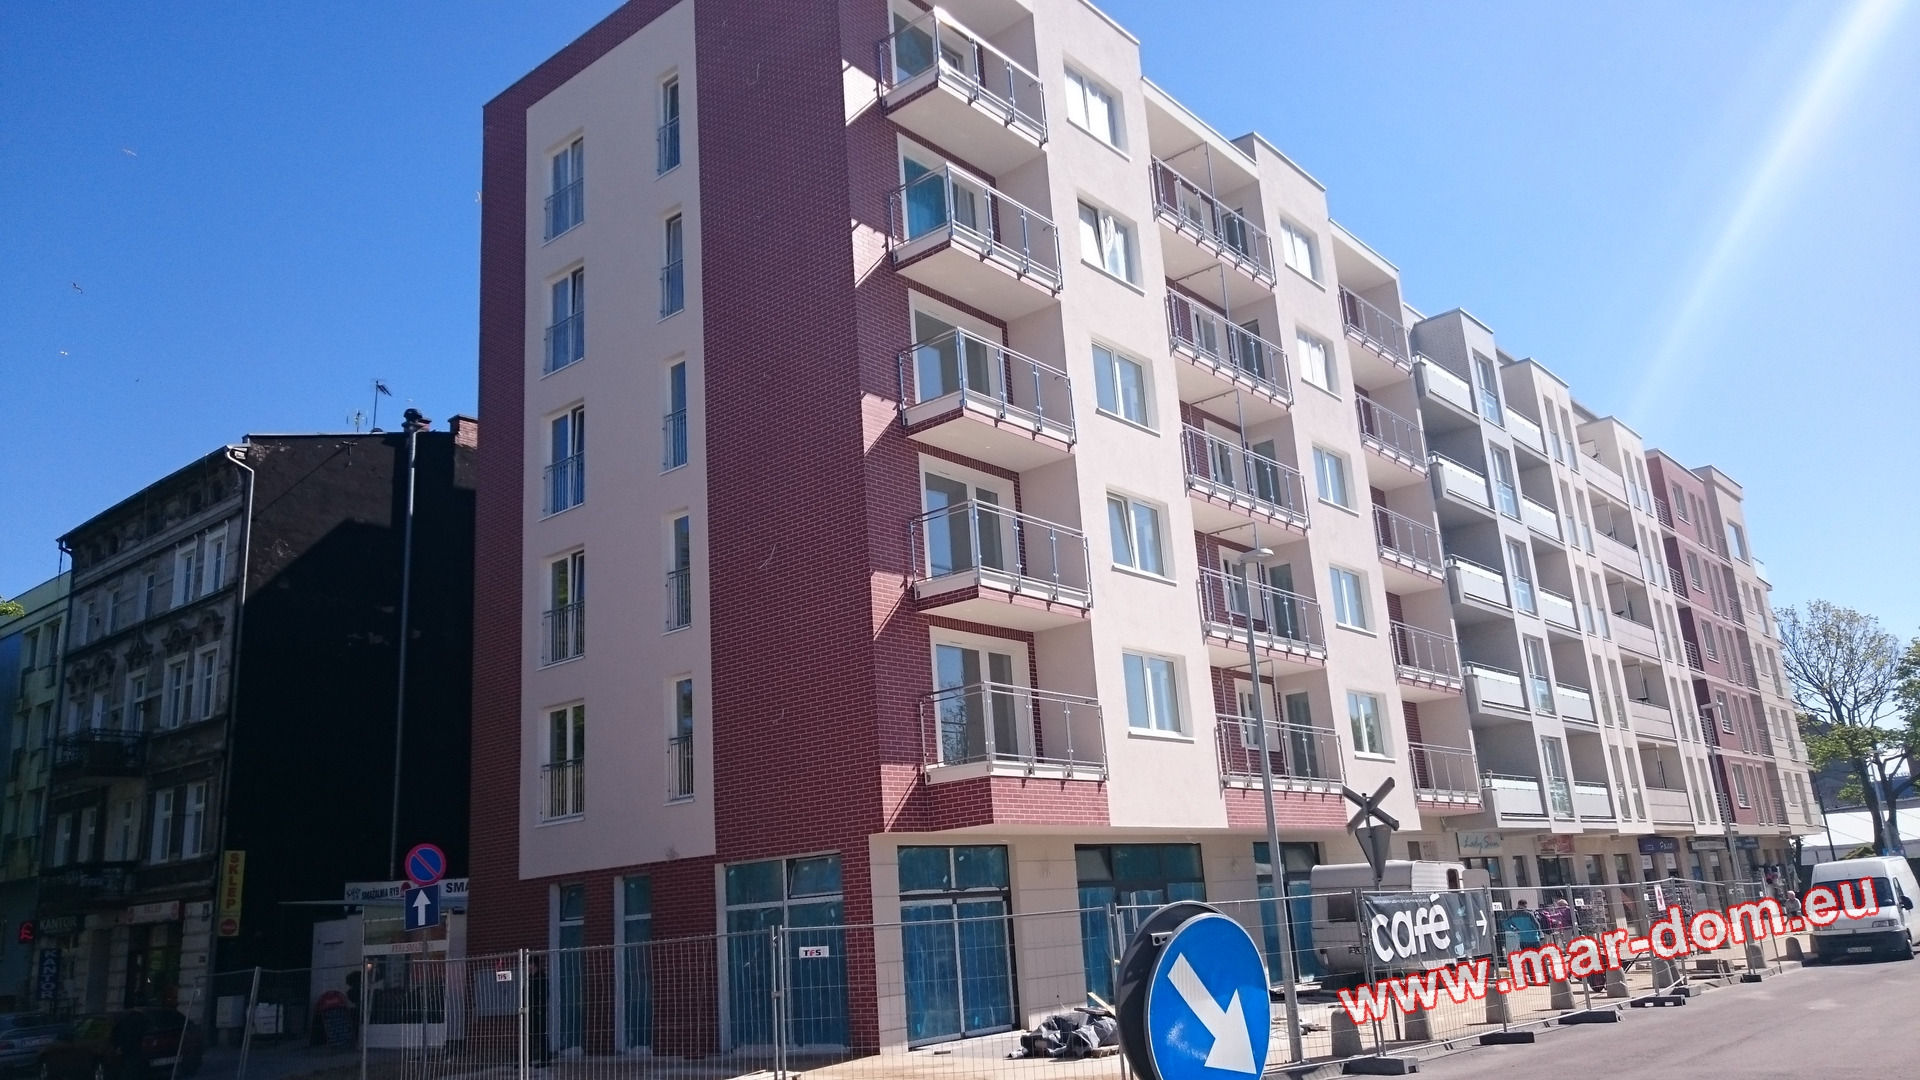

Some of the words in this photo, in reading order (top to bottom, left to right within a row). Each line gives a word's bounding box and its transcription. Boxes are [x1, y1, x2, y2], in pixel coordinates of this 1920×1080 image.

[226, 852, 239, 909] SKLEP
[389, 886, 399, 897] RYB
[39, 916, 77, 930] KANTOR
[1371, 892, 1451, 963] café
[40, 950, 57, 999] KANTOR
